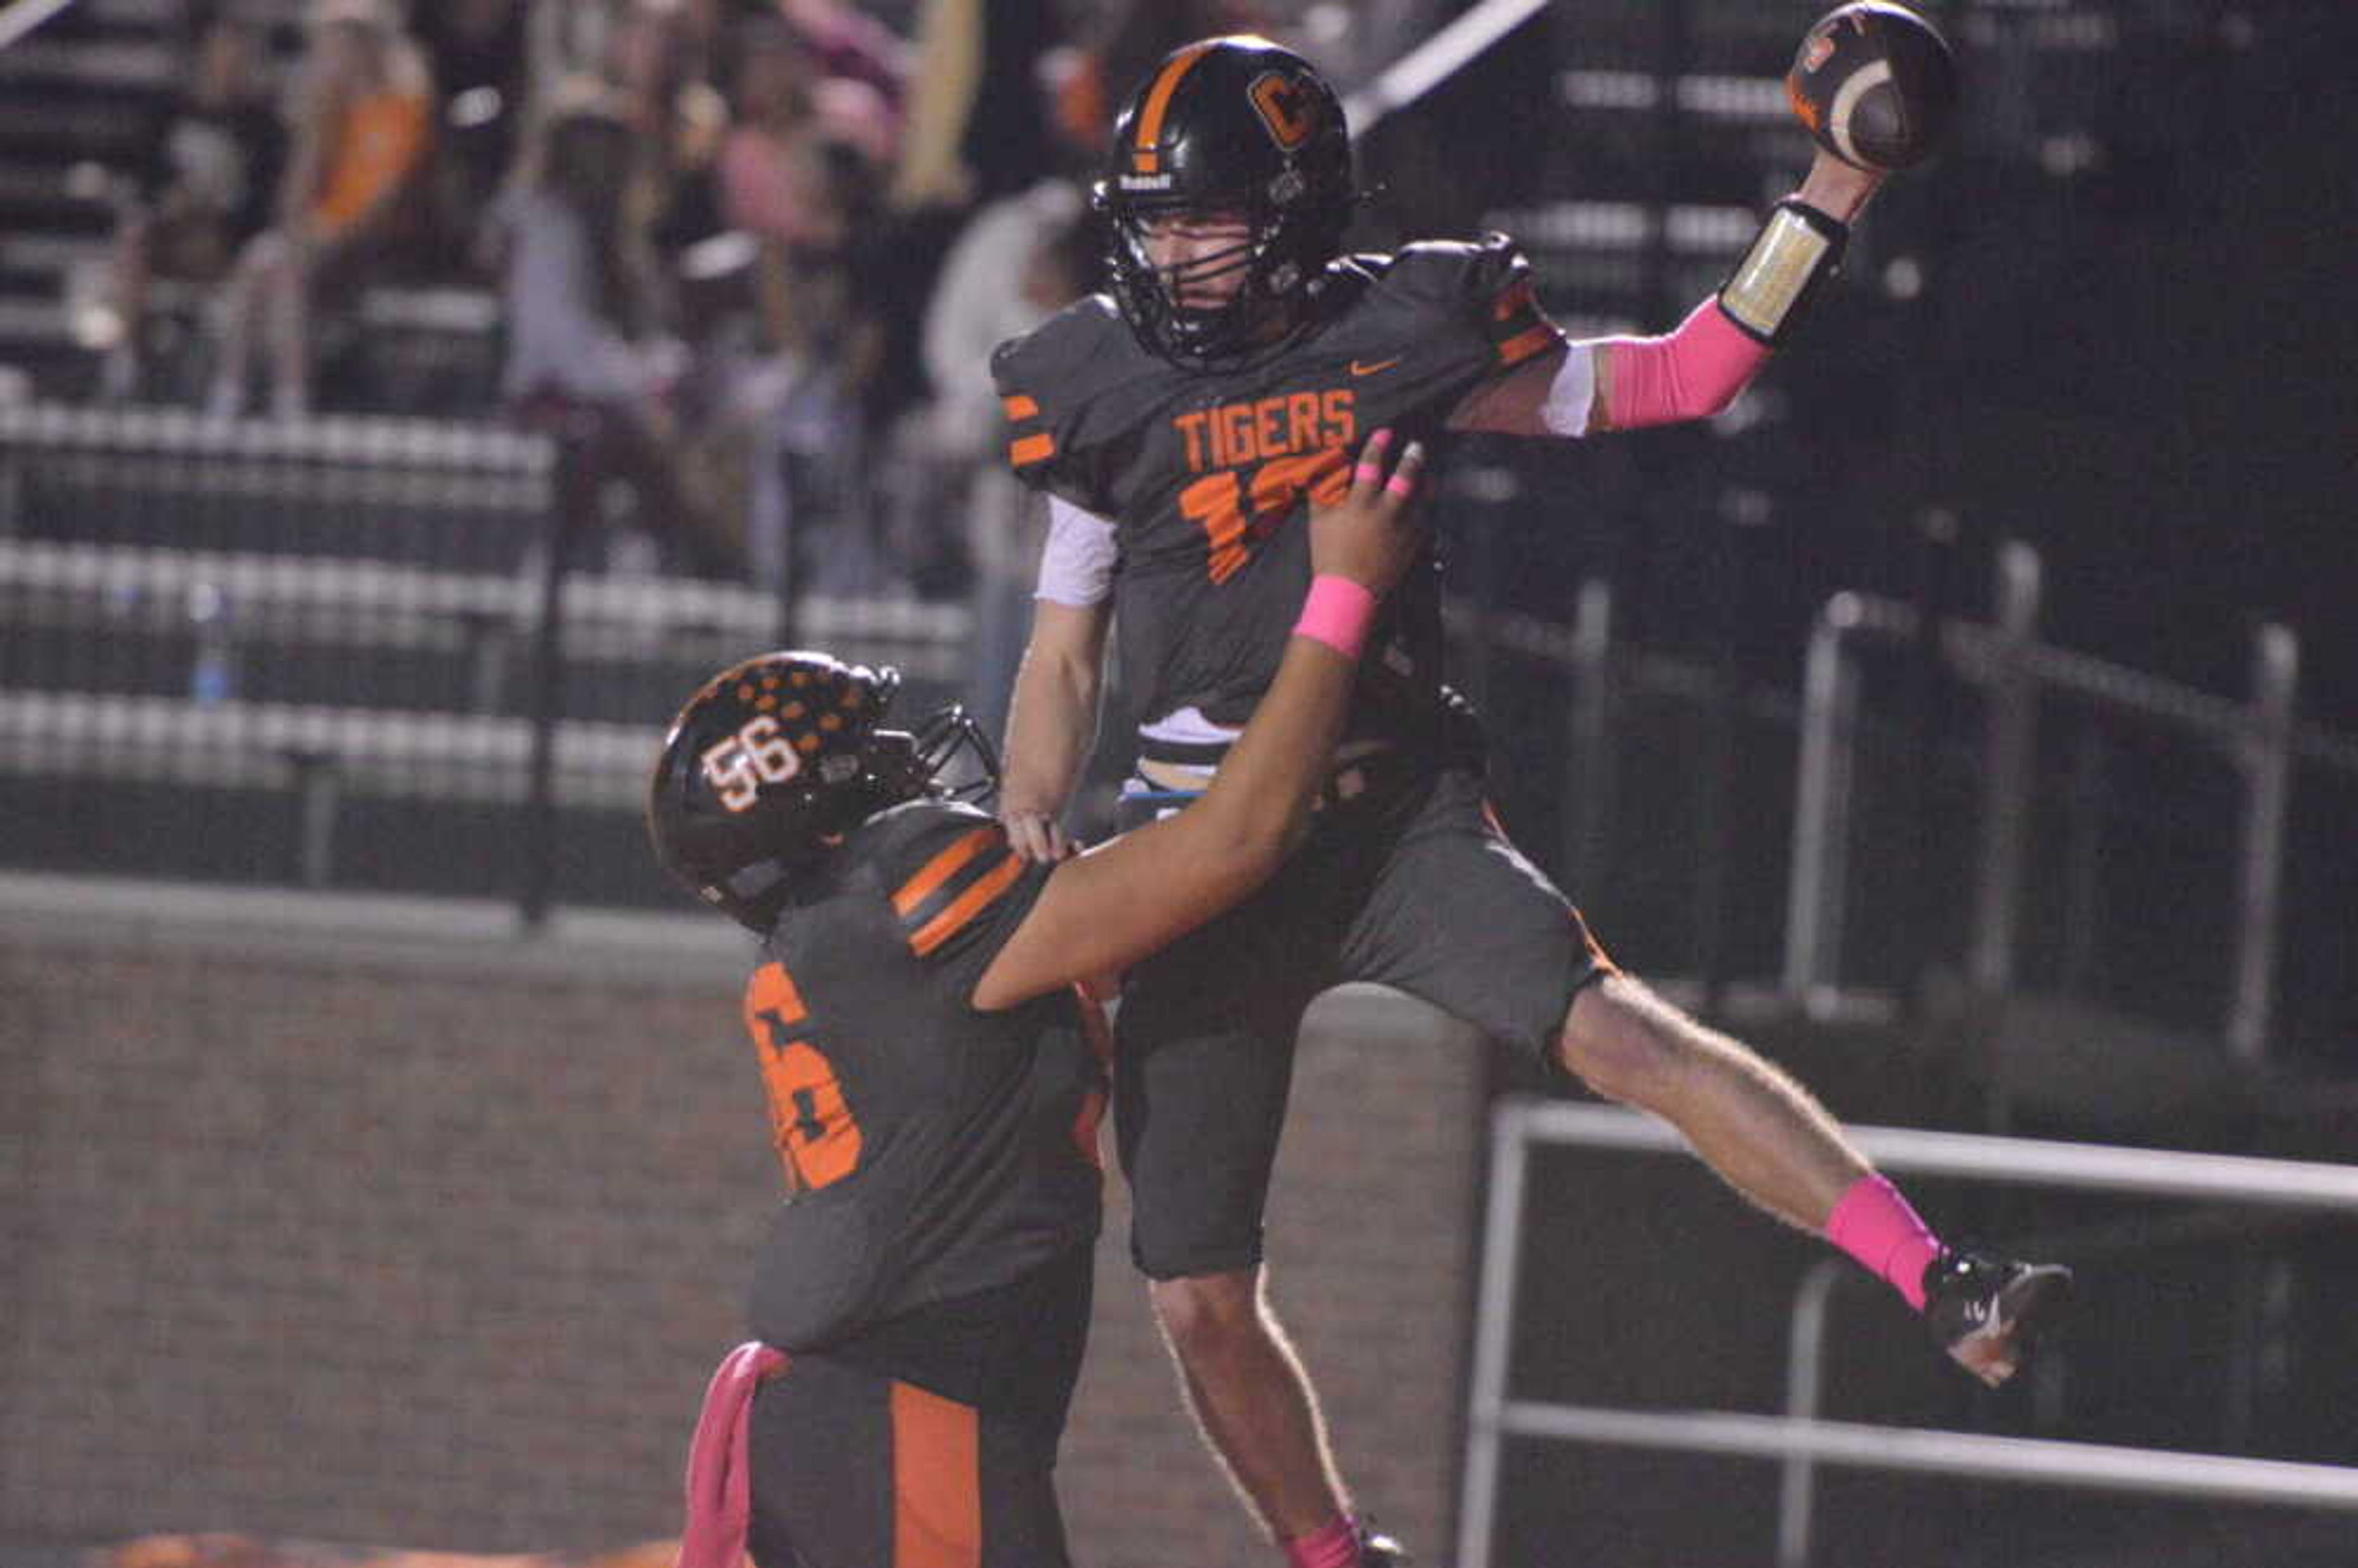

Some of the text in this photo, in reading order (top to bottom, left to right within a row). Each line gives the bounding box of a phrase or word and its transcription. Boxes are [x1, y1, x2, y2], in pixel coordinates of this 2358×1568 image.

[1246, 69, 1312, 152] C
[1173, 389, 1357, 472] TIGERS
[701, 716, 801, 812] 56
